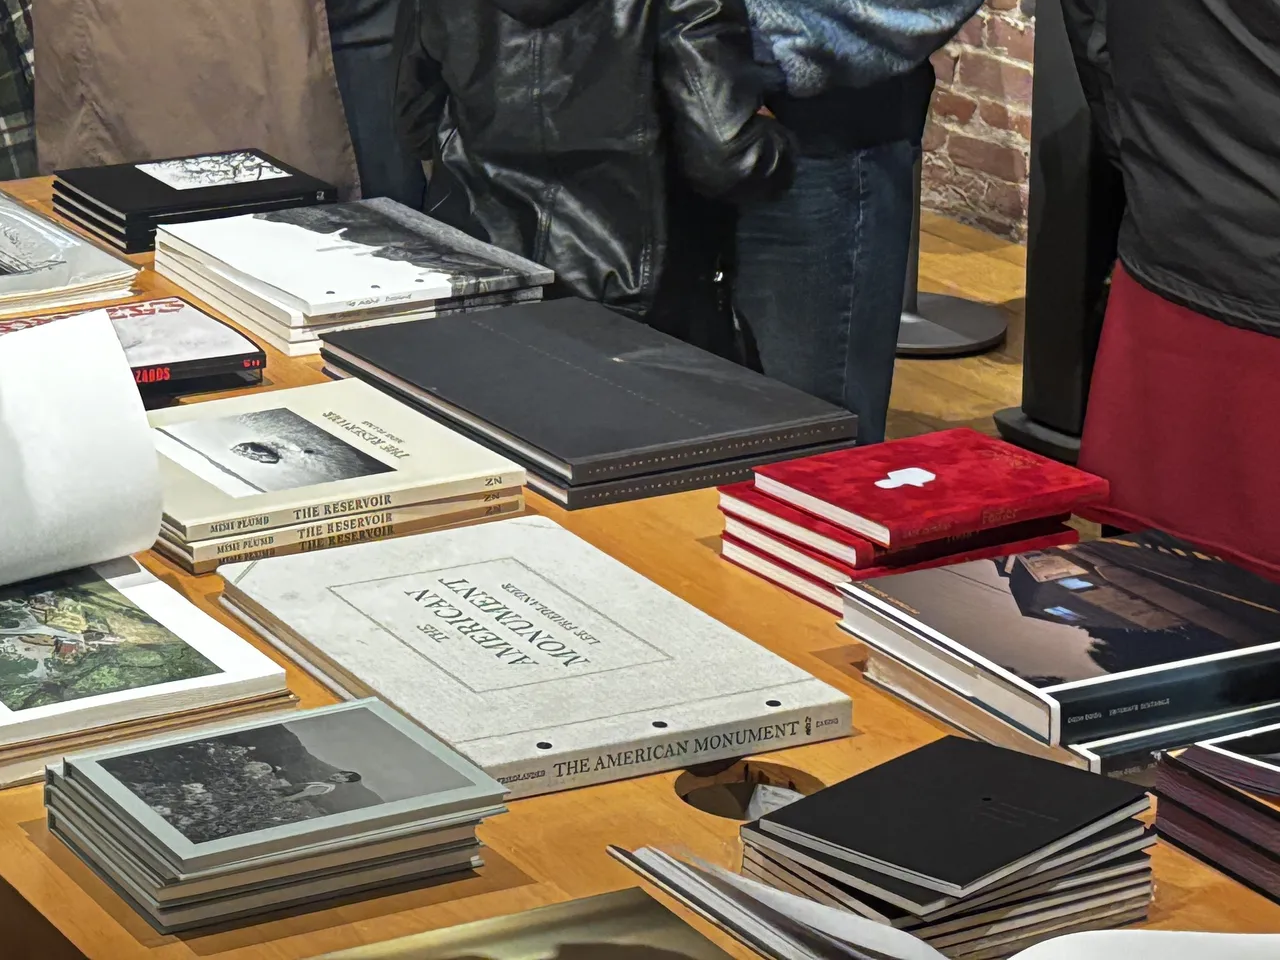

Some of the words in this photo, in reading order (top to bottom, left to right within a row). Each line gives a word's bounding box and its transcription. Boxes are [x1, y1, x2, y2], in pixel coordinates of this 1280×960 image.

[484, 476, 503, 486] ZN
[293, 506, 319, 520] THE
[323, 494, 392, 516] RESERVOIR
[297, 525, 323, 539] THE
[327, 512, 393, 533] RESERVOIR
[299, 539, 324, 551] THE
[328, 525, 394, 547] RESERVOIR
[404, 589, 540, 667] AMERICAN
[416, 623, 450, 643] THE
[438, 577, 591, 668] MONUMENT
[553, 757, 591, 778] THE
[593, 739, 690, 772] AMERICAN
[693, 720, 800, 753] MONUMENT
